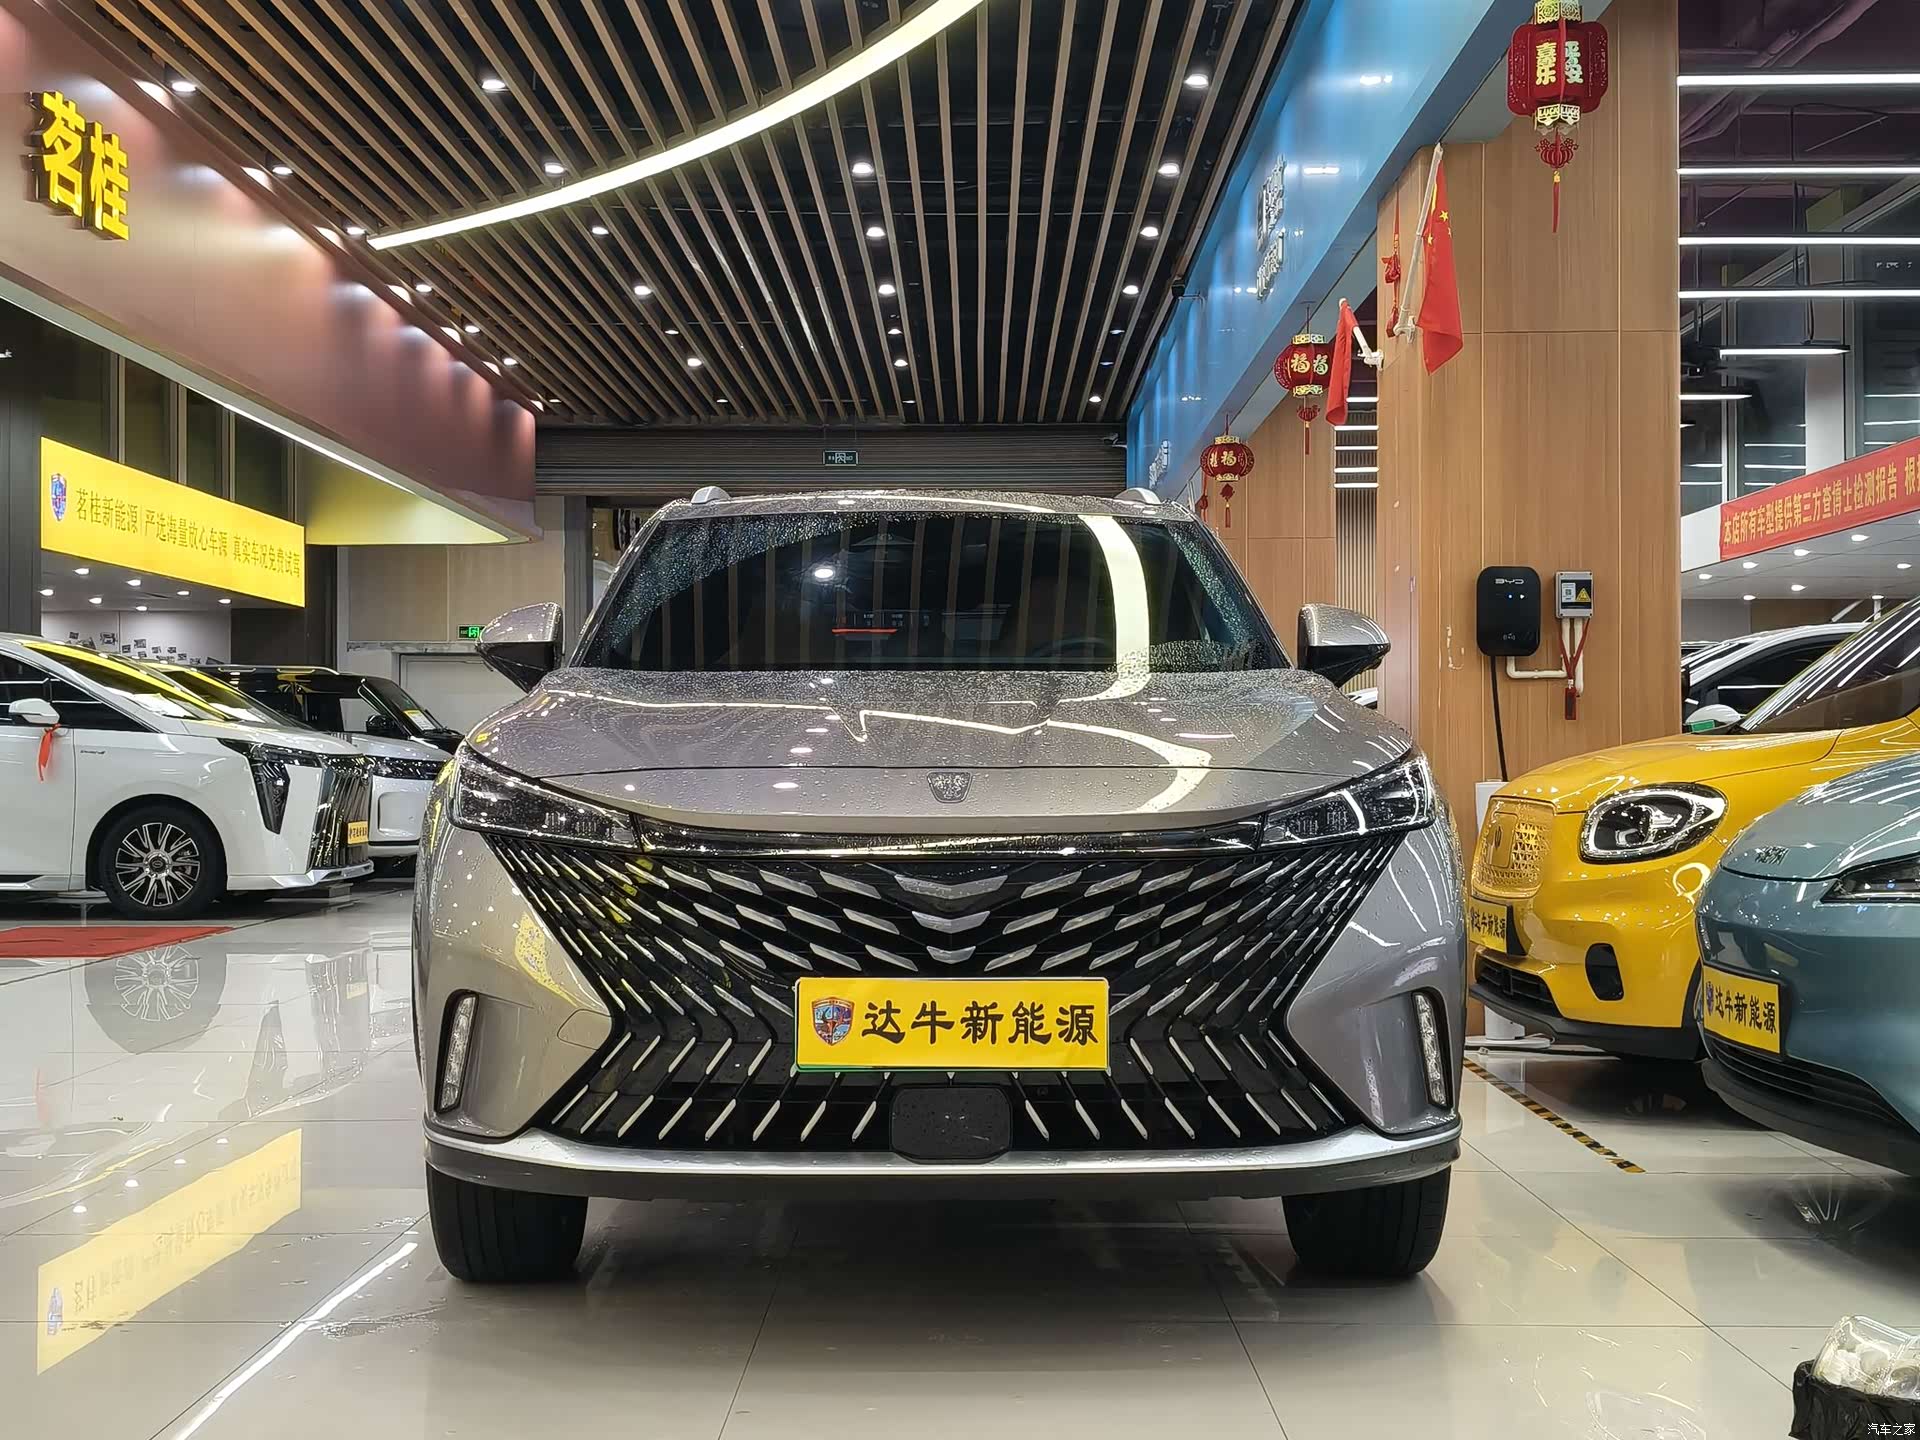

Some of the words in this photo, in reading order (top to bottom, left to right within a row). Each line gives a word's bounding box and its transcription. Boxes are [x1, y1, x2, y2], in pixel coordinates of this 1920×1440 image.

[42, 91, 129, 240] 茗桂
[1291, 352, 1310, 373] 福
[1313, 353, 1329, 375] 福
[1220, 450, 1237, 467] 福
[76, 487, 138, 534] 茗桂新能源
[144, 508, 228, 557] 严选海量放心车源
[1723, 461, 1897, 546] 本店所有车型提供第三方查博士检测报告
[860, 999, 1099, 1046] 达牛新能源
[1715, 985, 1777, 1034] 达牛新能源
